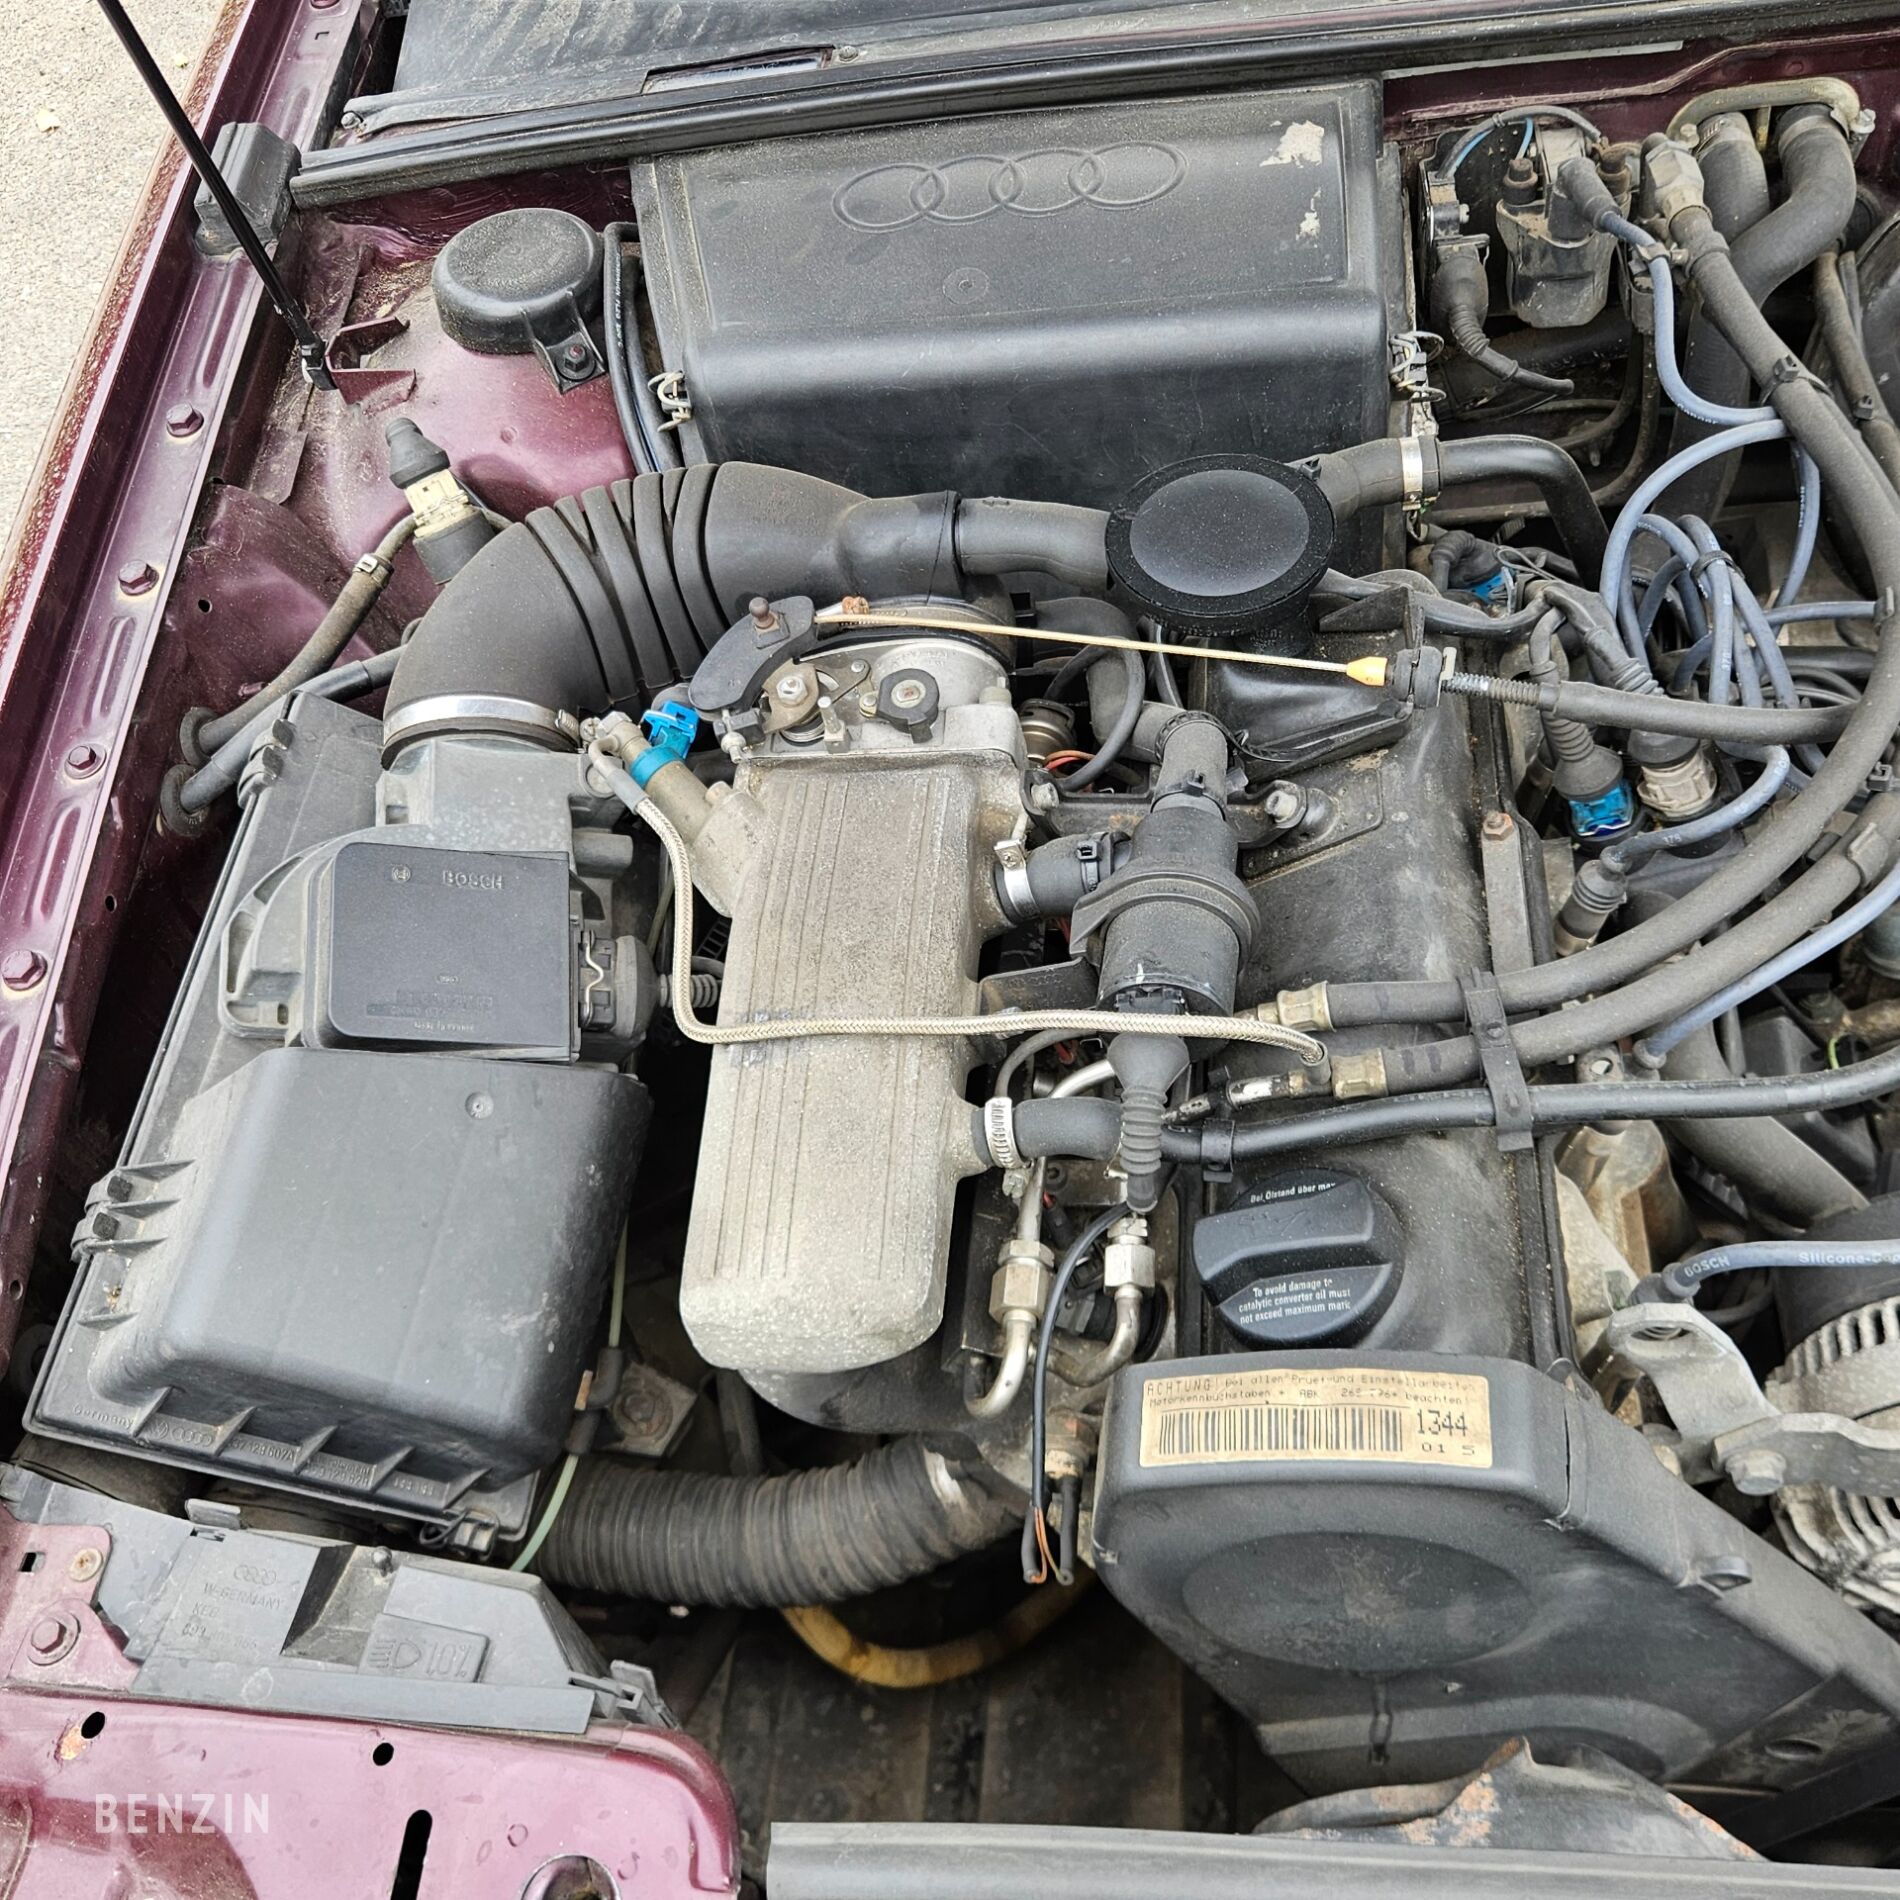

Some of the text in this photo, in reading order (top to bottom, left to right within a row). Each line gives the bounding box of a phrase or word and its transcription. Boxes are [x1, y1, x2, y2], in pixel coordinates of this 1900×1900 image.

[442, 869, 503, 890] BOSCH
[1297, 1184, 1316, 1194] über
[1684, 1255, 1731, 1278] BOSCH
[1238, 1288, 1351, 1313] catalytic converter oil must
[1252, 1286, 1263, 1298] To
[1264, 1281, 1287, 1295] avoid
[1288, 1280, 1322, 1292] damage
[1240, 1299, 1351, 1325] not exceed maximum mark
[1147, 1378, 1219, 1396] ACHTUNG!
[1251, 1374, 1284, 1386] allen
[72, 1403, 135, 1429] Germany
[1417, 1409, 1468, 1437] 1344
